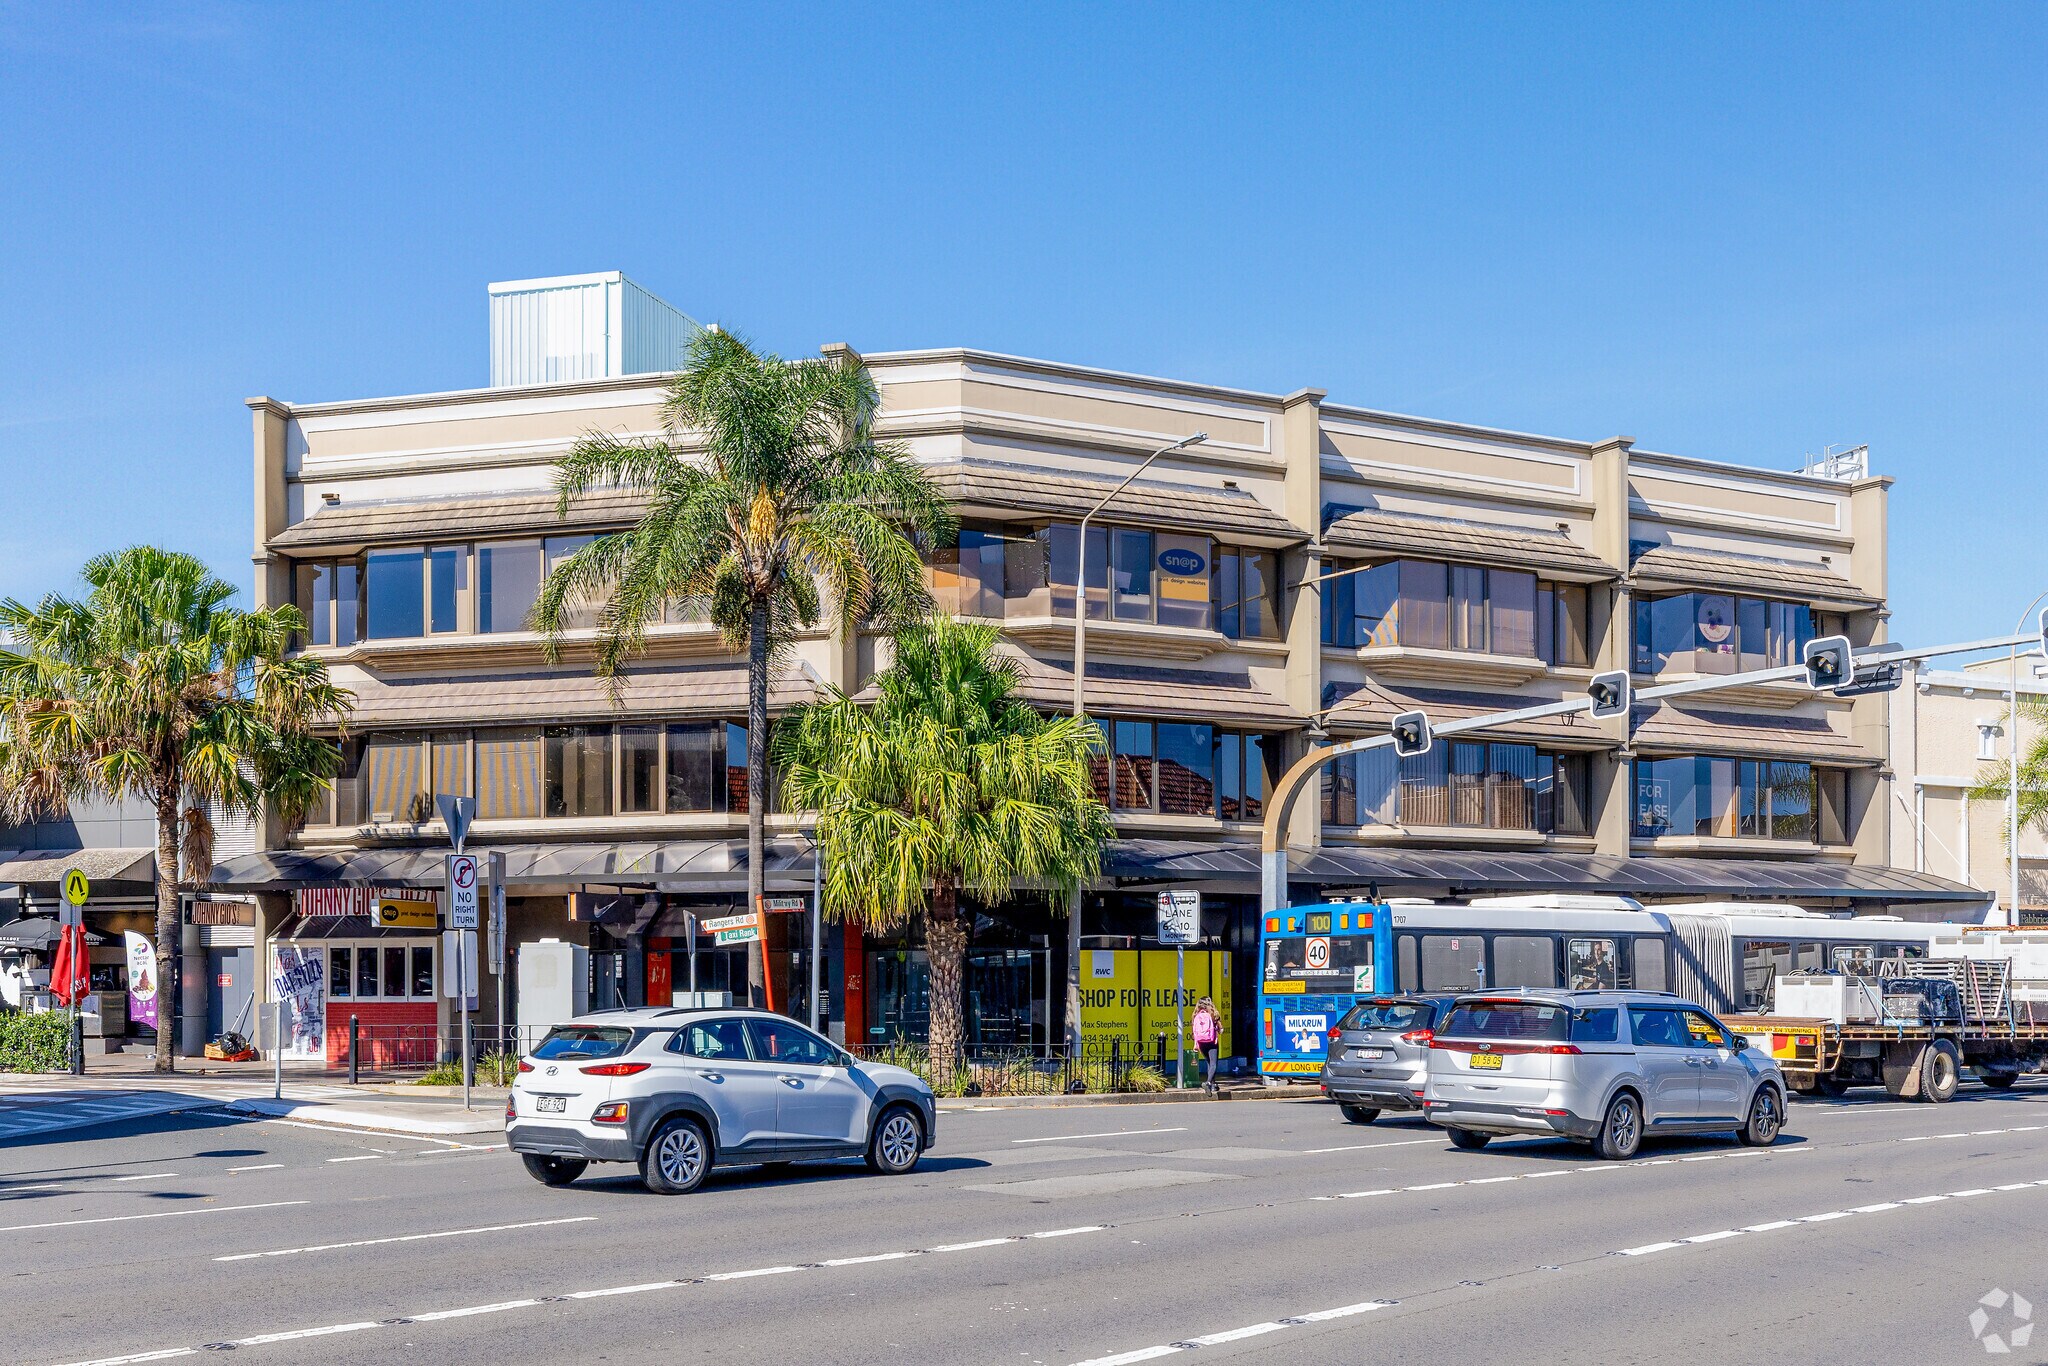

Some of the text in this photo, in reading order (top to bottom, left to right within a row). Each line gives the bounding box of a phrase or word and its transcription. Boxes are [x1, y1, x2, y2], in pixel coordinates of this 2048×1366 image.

[1640, 784, 1662, 798] FOR
[1640, 804, 1668, 817] EASE
[297, 887, 351, 916] JOHNNY
[457, 892, 472, 903] NO
[773, 899, 792, 908] Military
[193, 902, 220, 924] JOHNNY
[220, 903, 237, 925] GIO'S
[455, 906, 475, 914] RIGHT
[1165, 909, 1192, 918] LANE
[456, 916, 475, 924] TURN
[709, 916, 744, 929] Rangers Rd
[1311, 916, 1331, 931] 100
[1393, 915, 1407, 924] 1707
[724, 929, 755, 939] Taxi Rank
[1309, 945, 1327, 961] 40
[275, 958, 324, 999] DAT PIZZA
[1079, 989, 1115, 1008] SHOP
[1120, 989, 1152, 1007] FOR
[1096, 1020, 1128, 1029] Stephens
[1151, 1020, 1172, 1029] Logan
[1288, 1019, 1323, 1027] MILKRUN
[1080, 1033, 1097, 1042] 434
[1290, 1063, 1311, 1072] LONG
